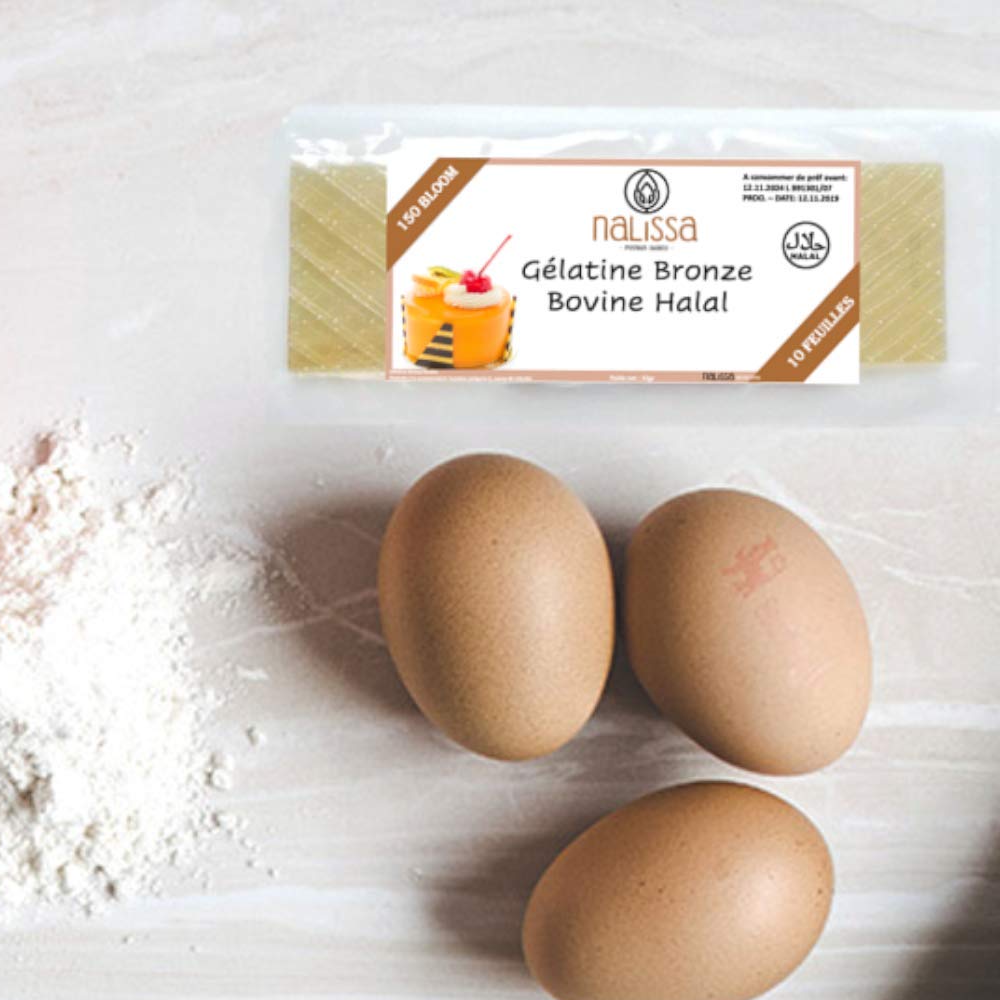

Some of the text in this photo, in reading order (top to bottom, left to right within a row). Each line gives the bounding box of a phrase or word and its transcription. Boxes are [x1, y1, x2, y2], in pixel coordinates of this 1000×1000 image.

[397, 165, 459, 231] 150 BLOOM
[786, 231, 826, 251] حلال
[790, 252, 821, 260] HALAL
[521, 257, 752, 282] Gélatine Bronze
[548, 290, 728, 312] Bovine Halal
[786, 294, 855, 368] 10 FEUILLES
